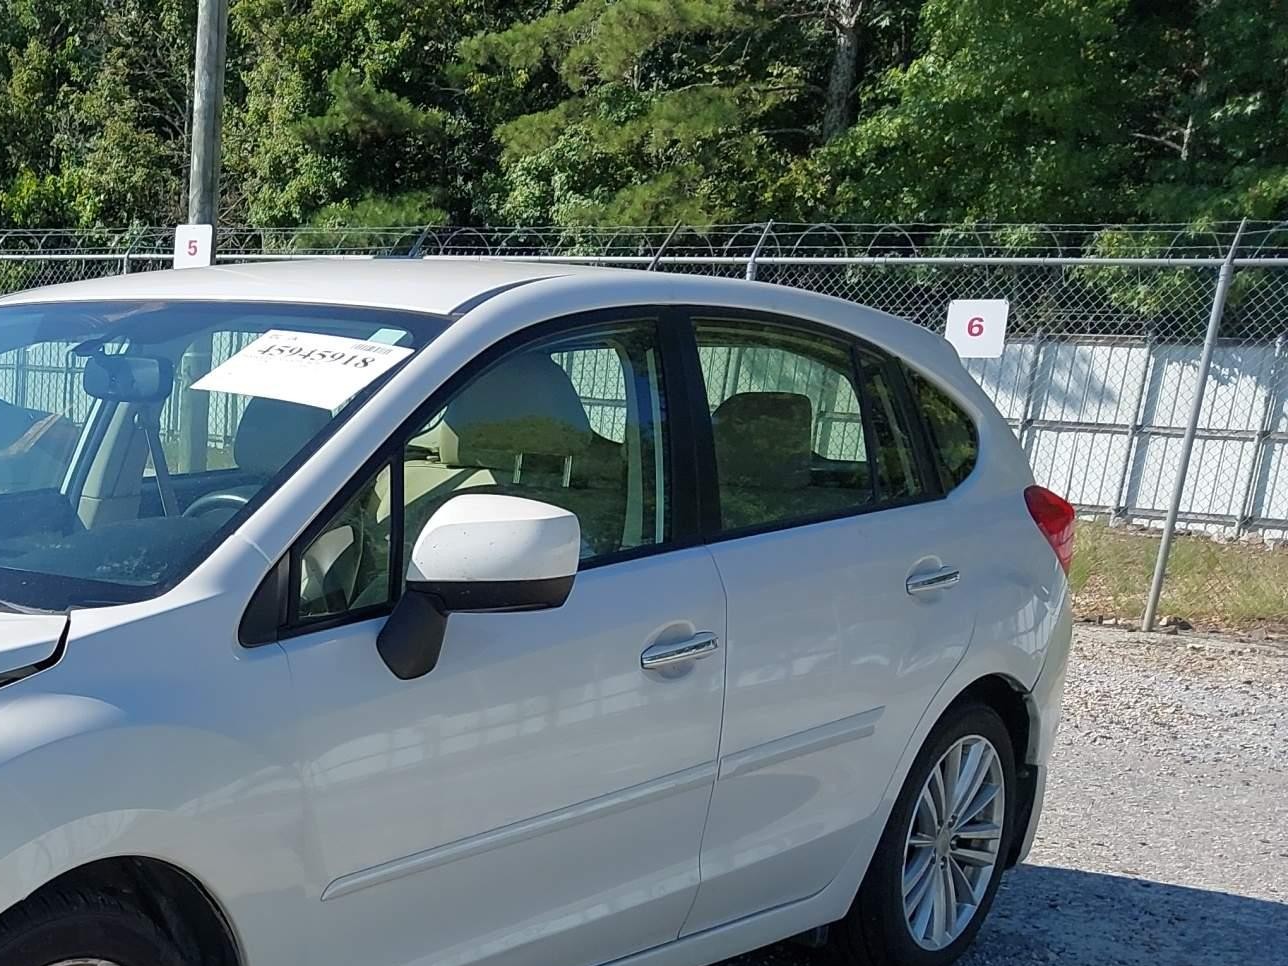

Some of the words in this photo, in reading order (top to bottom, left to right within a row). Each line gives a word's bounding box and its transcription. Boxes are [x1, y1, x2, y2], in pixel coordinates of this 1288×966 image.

[187, 239, 198, 257] 5
[967, 317, 984, 337] 6
[257, 344, 376, 368] 45945918
